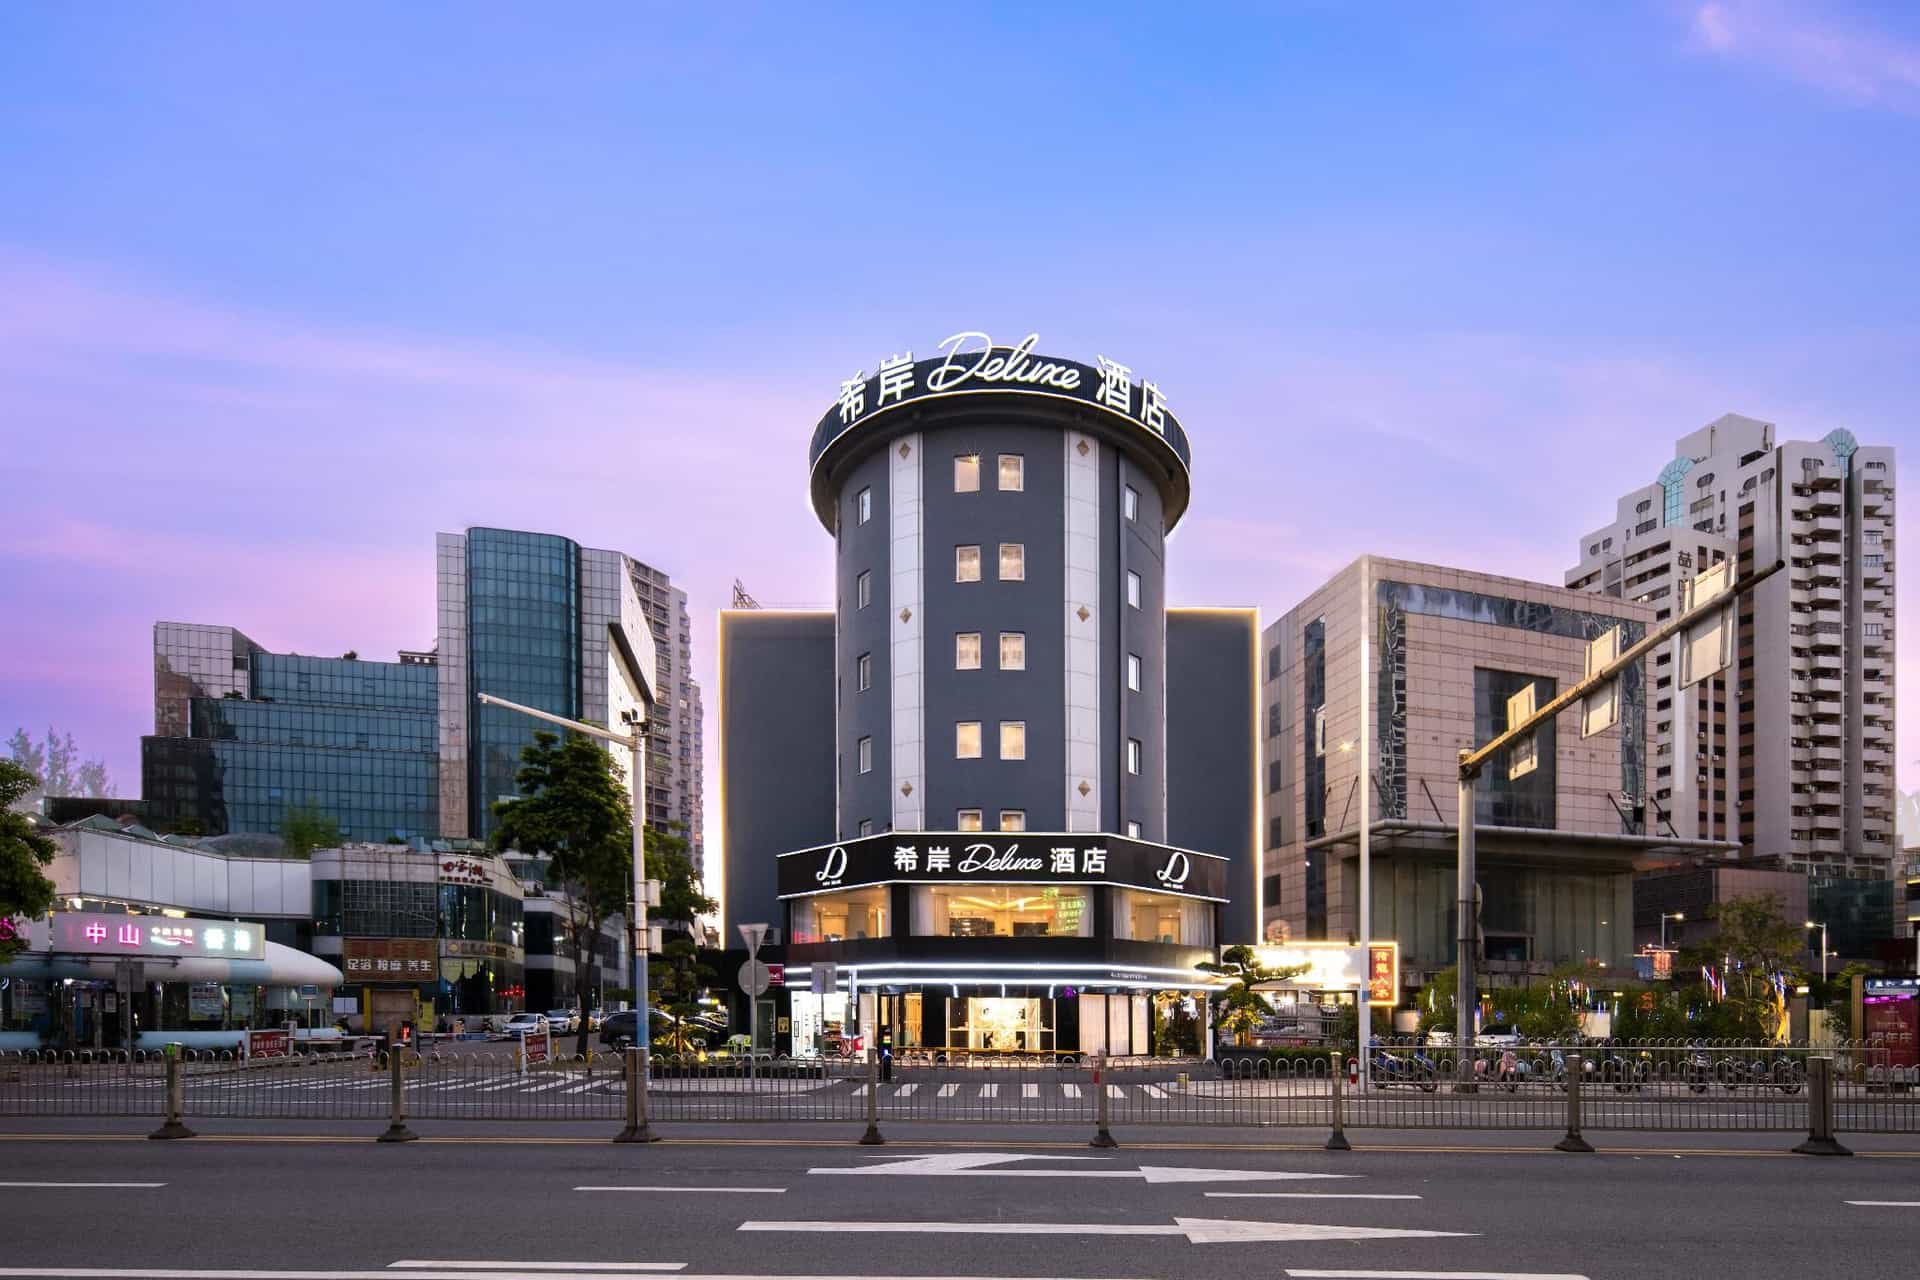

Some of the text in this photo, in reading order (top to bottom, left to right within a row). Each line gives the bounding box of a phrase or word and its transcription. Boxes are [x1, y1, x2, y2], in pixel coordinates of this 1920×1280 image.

[838, 331, 1168, 435] 希岸 Deluxe 酒店
[893, 843, 1108, 874] 希岸 Deluxe 酒店
[85, 921, 141, 946] 中山
